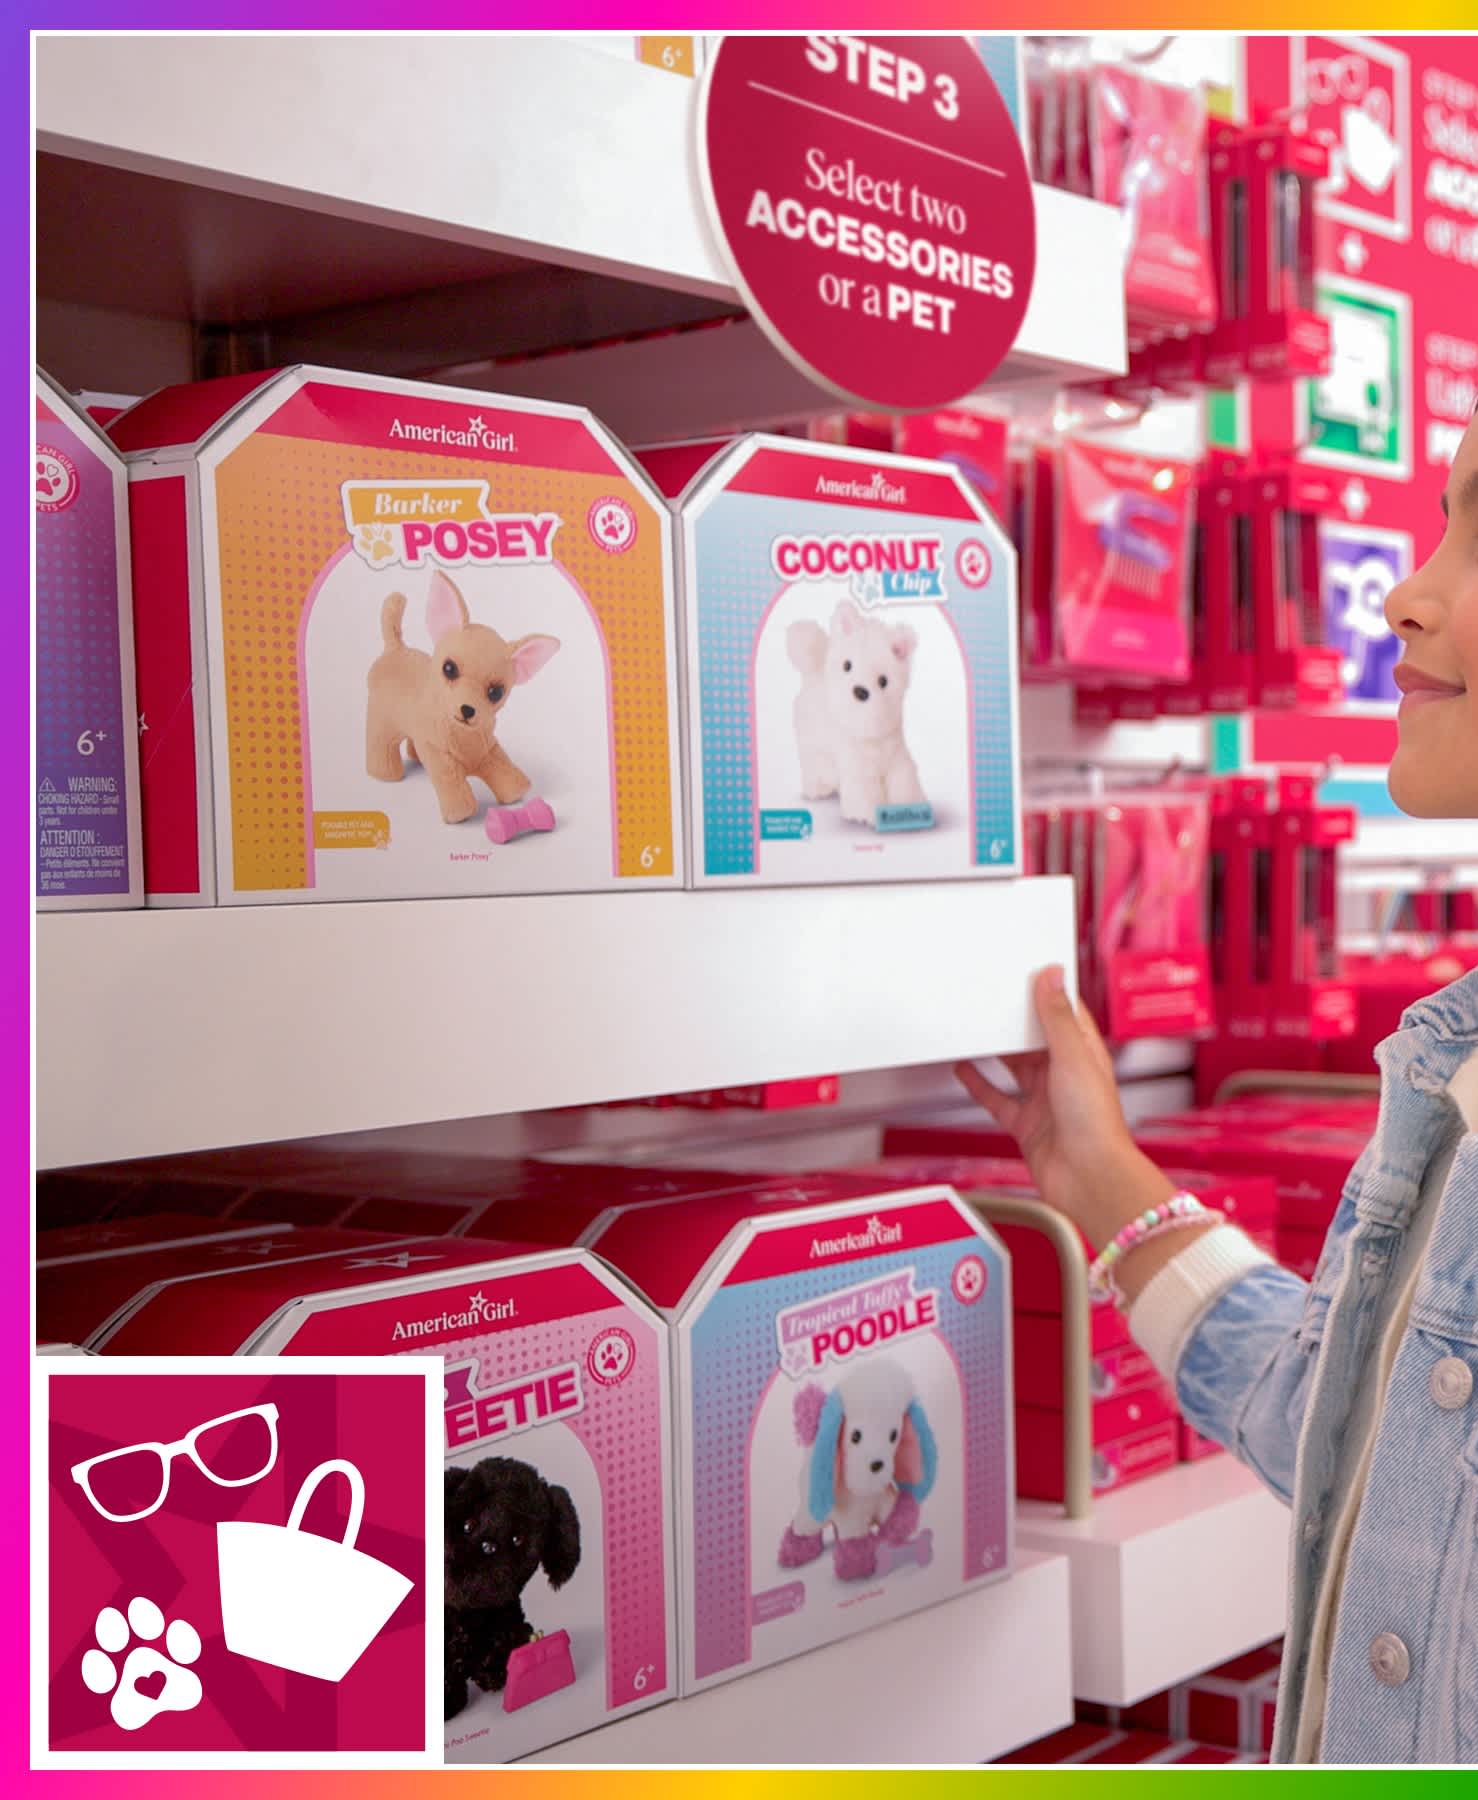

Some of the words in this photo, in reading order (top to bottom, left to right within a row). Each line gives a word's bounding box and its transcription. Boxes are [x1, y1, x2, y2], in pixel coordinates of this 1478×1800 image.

[805, 36, 927, 103] STEP
[934, 74, 960, 121] 3
[805, 147, 904, 217] Select
[911, 184, 967, 235] two
[746, 189, 1015, 300] ACCESSORIES
[818, 272, 856, 309] or
[862, 284, 882, 318] a
[887, 283, 957, 335] PET
[389, 418, 478, 448] American
[481, 430, 515, 452] Girl
[374, 491, 463, 516] Barker
[815, 475, 879, 500] American
[881, 484, 907, 504] Girl
[402, 520, 554, 561] POSEY
[776, 539, 941, 576] COCONUT
[889, 573, 933, 596] Chip
[77, 729, 107, 756] 6+
[67, 776, 118, 793] WARNING:
[40, 829, 95, 845] ATTENTION
[640, 845, 661, 868] 6+
[808, 1231, 875, 1259] American
[877, 1223, 903, 1246] Girl
[391, 1308, 479, 1341] American
[482, 1297, 515, 1321] Girl
[785, 1295, 858, 1337] Tropical
[811, 1295, 936, 1365] POODLE
[444, 1370, 577, 1449] EETIE
[633, 1664, 656, 1690] 6+
